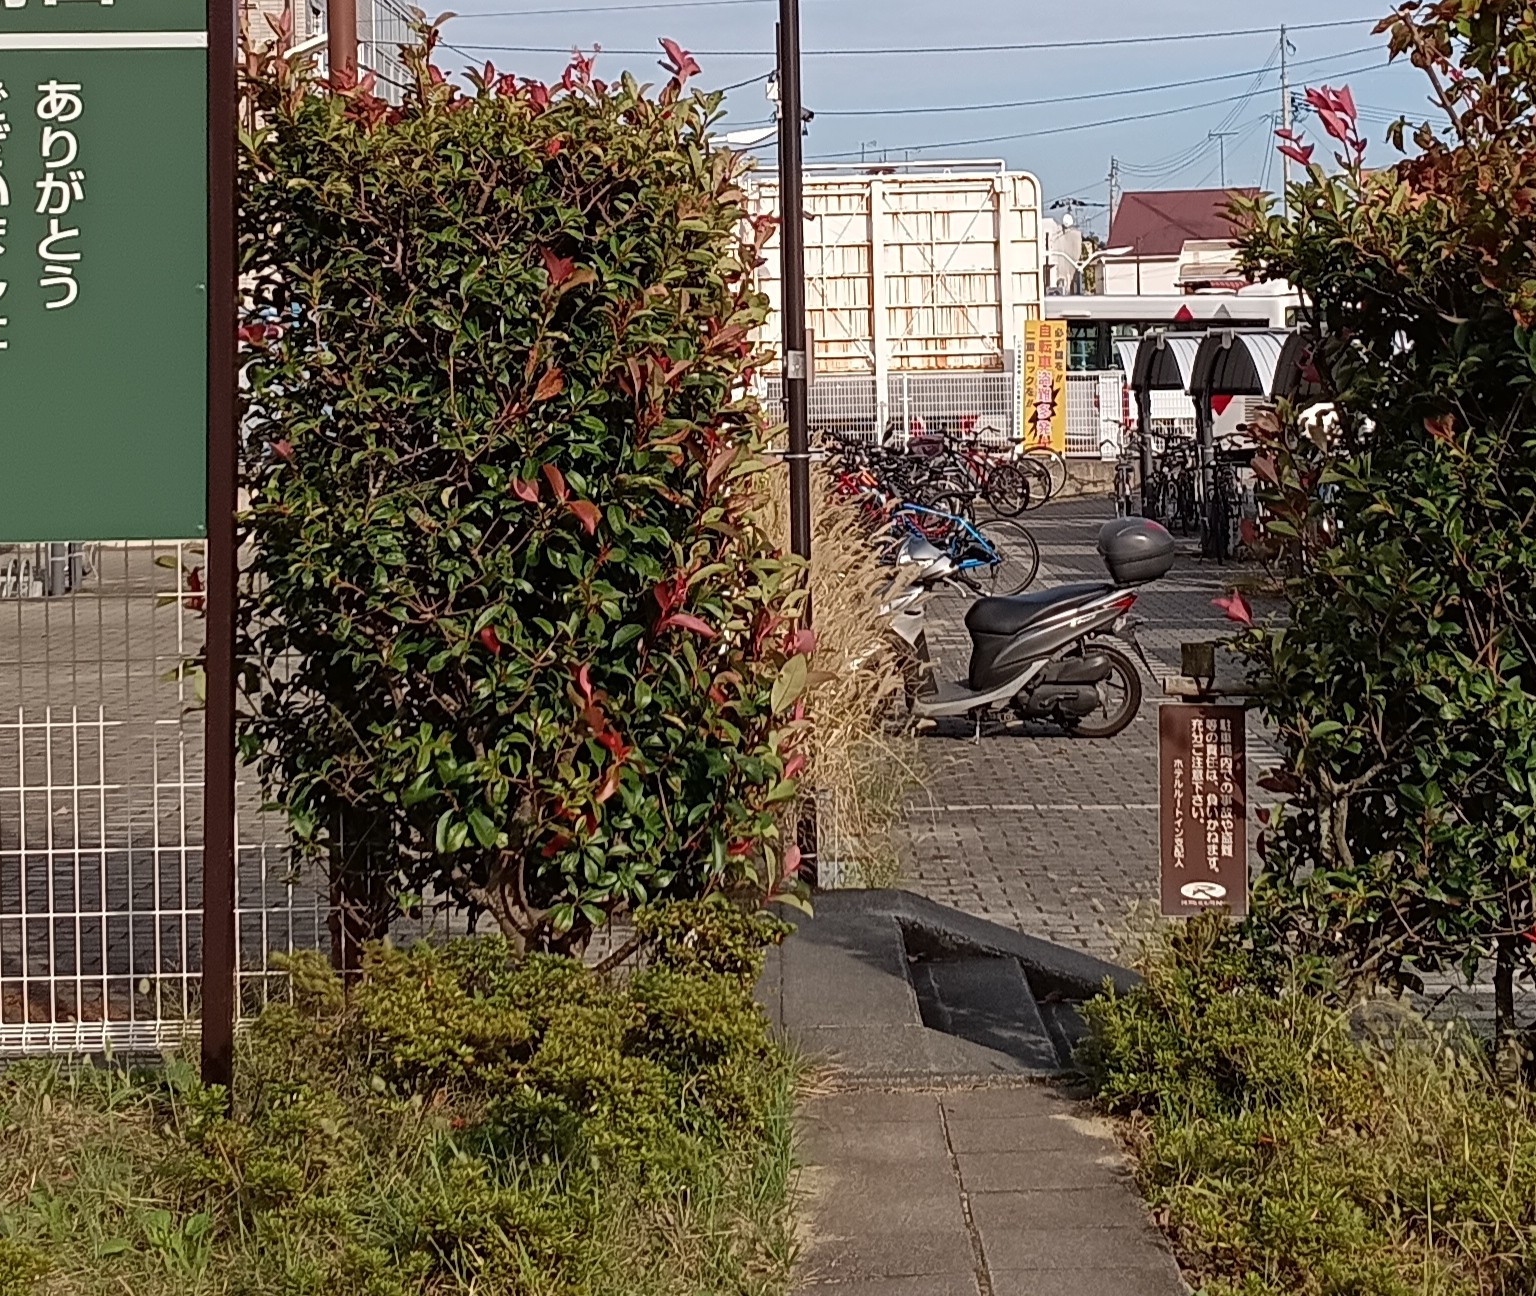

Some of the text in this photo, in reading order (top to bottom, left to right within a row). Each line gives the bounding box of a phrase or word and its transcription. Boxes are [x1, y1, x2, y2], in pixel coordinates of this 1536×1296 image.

[35, 79, 86, 310] ありがとう
